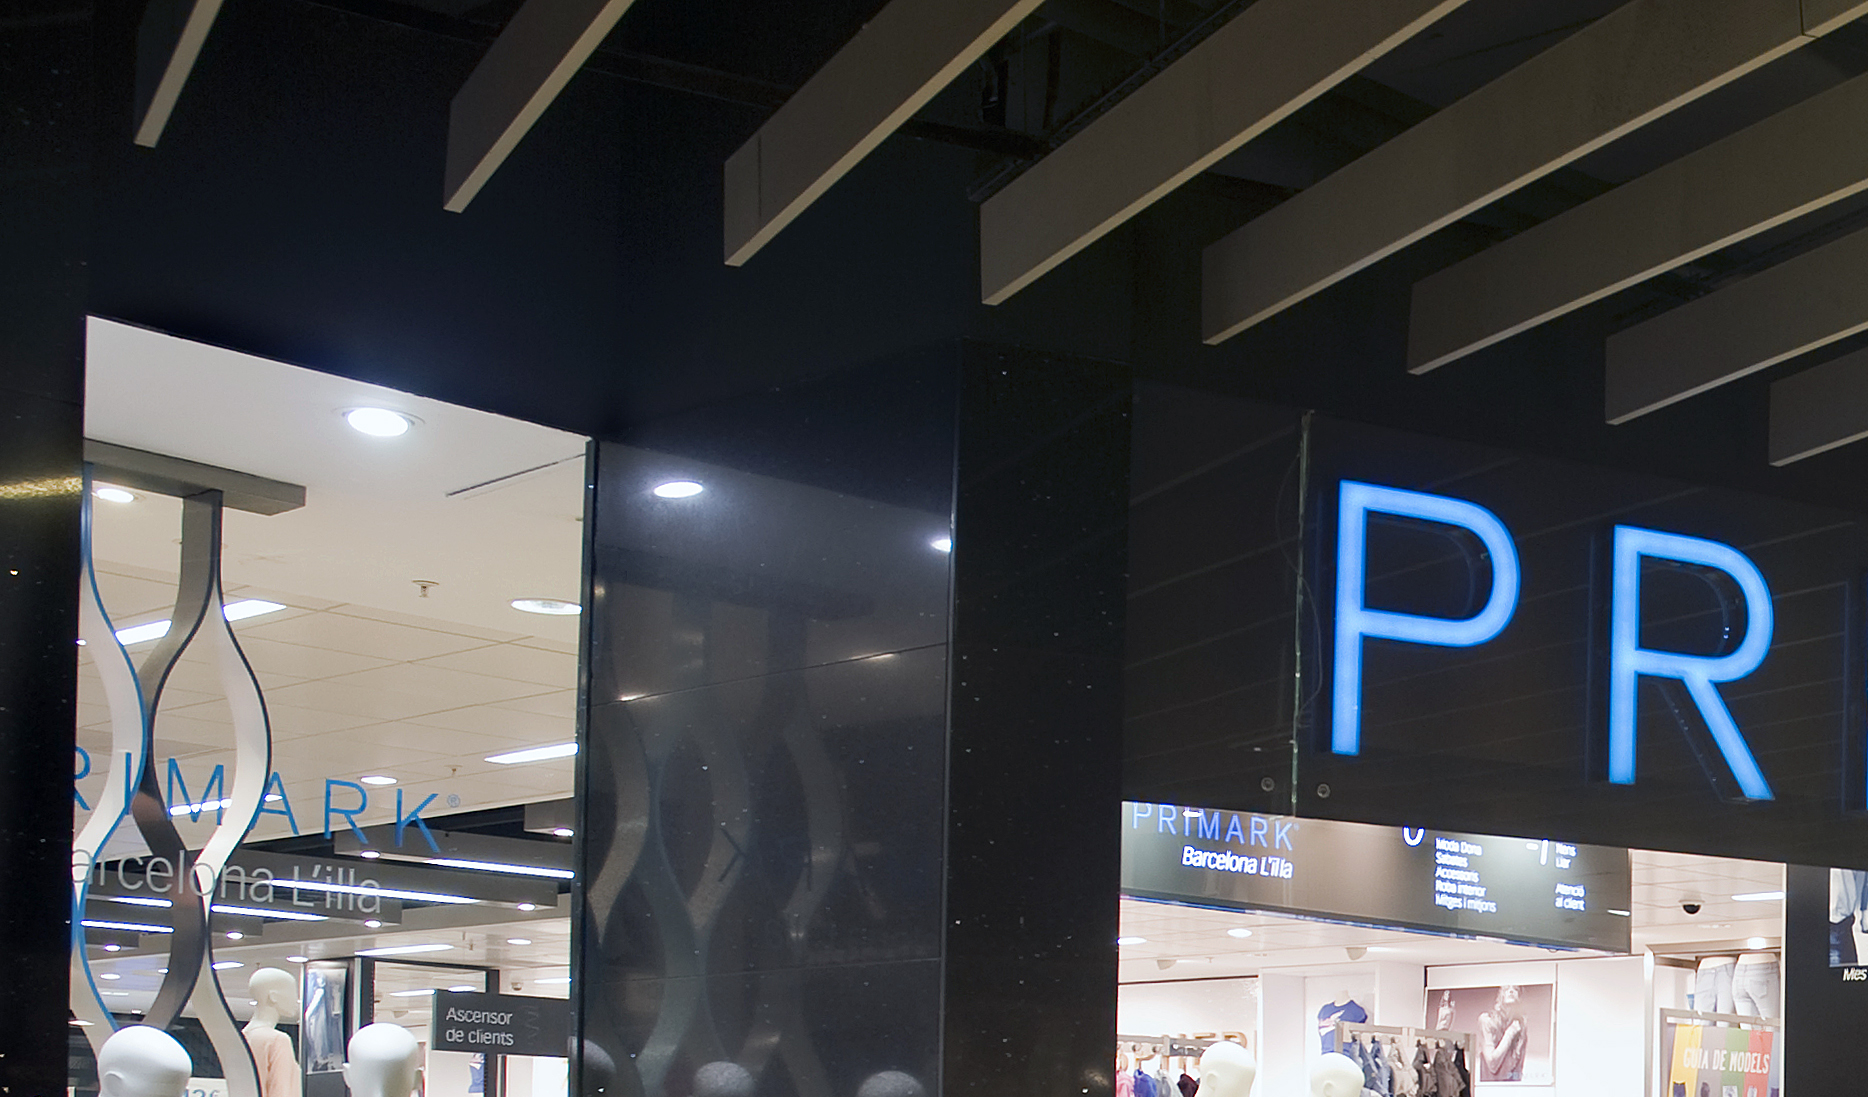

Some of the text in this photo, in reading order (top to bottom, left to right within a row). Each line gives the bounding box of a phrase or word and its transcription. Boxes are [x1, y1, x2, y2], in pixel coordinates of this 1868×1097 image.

[1132, 801, 1293, 851] PRIMARK
[1182, 845, 1258, 875] Barcelona
[1842, 967, 1868, 982] Mes
[445, 1006, 513, 1026] Ascensor
[445, 1028, 515, 1047] de clients
[1712, 1050, 1728, 1071] DE
[1729, 1051, 1770, 1074] MODELS
